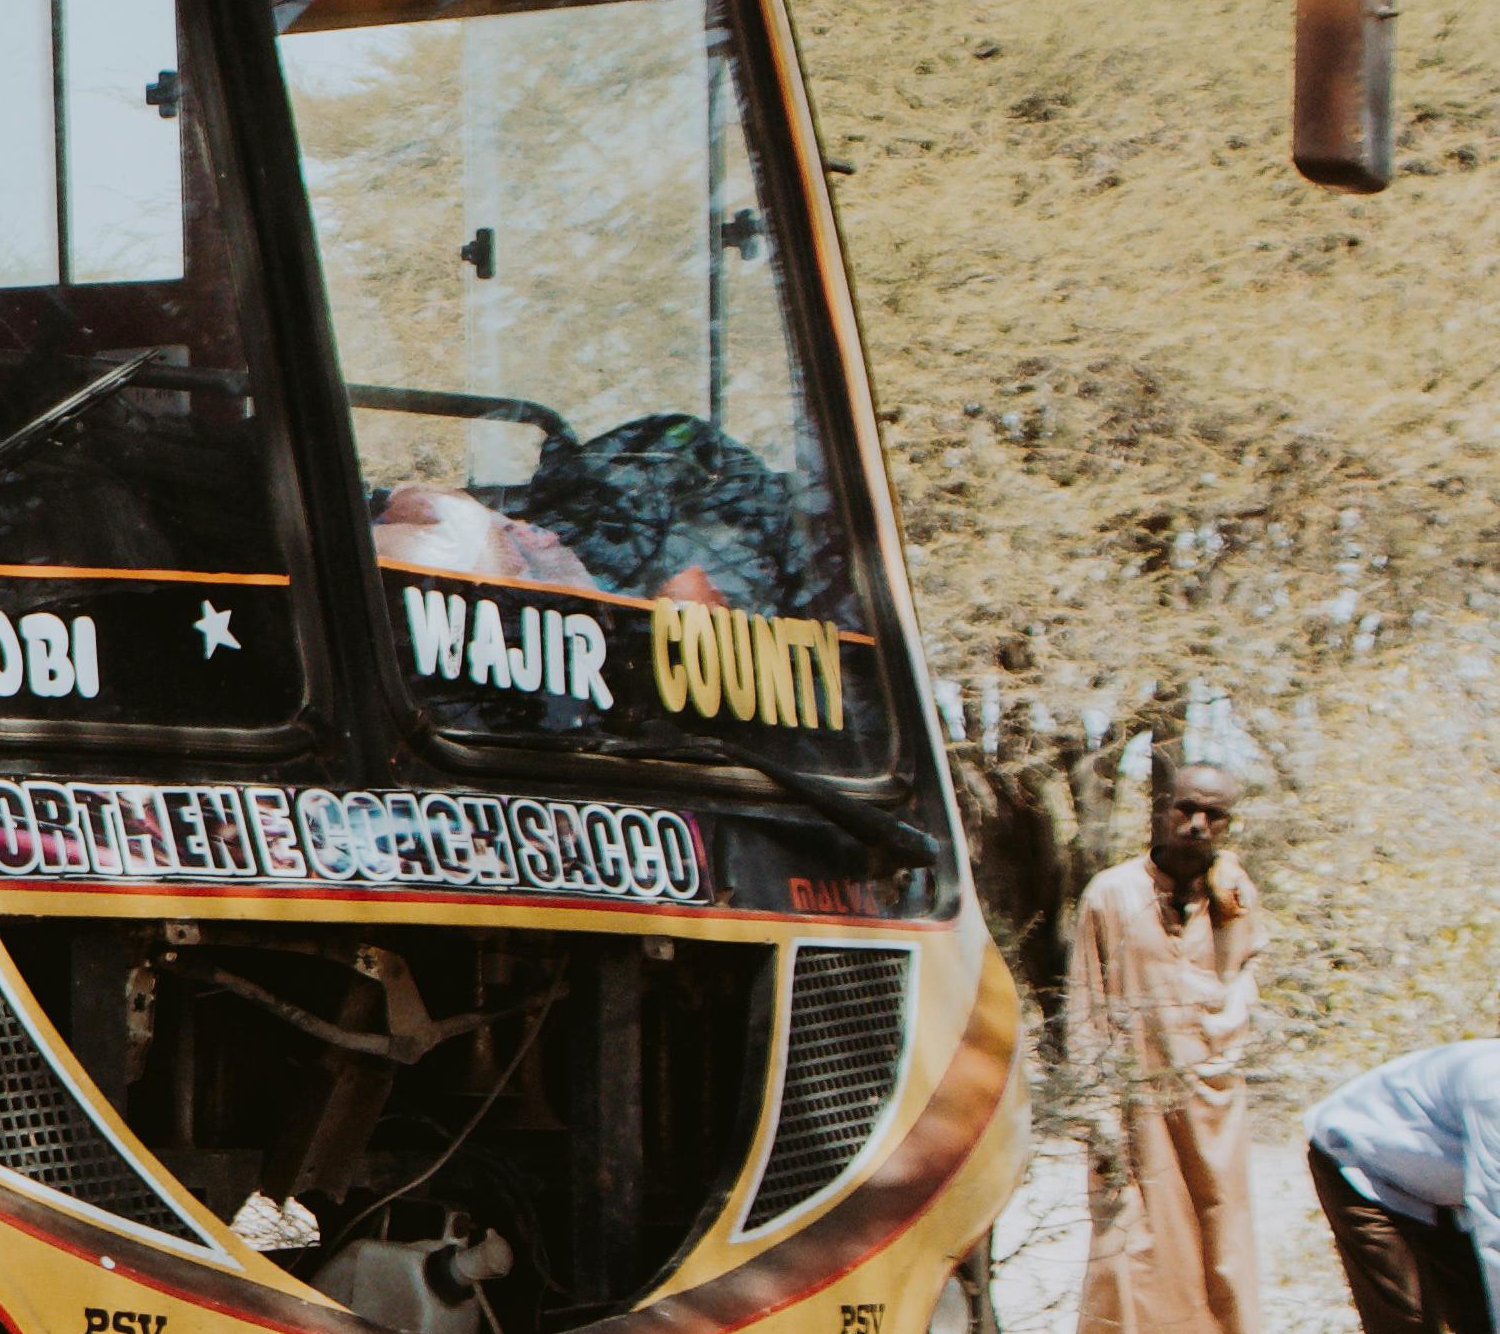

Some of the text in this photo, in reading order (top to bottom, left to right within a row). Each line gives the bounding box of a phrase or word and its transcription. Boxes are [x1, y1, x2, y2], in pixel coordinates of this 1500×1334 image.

[404, 585, 615, 711] WAJIR
[650, 596, 844, 731] COUNTY
[244, 786, 307, 878] E
[298, 787, 520, 887] COACH
[506, 798, 700, 899] SACCO
